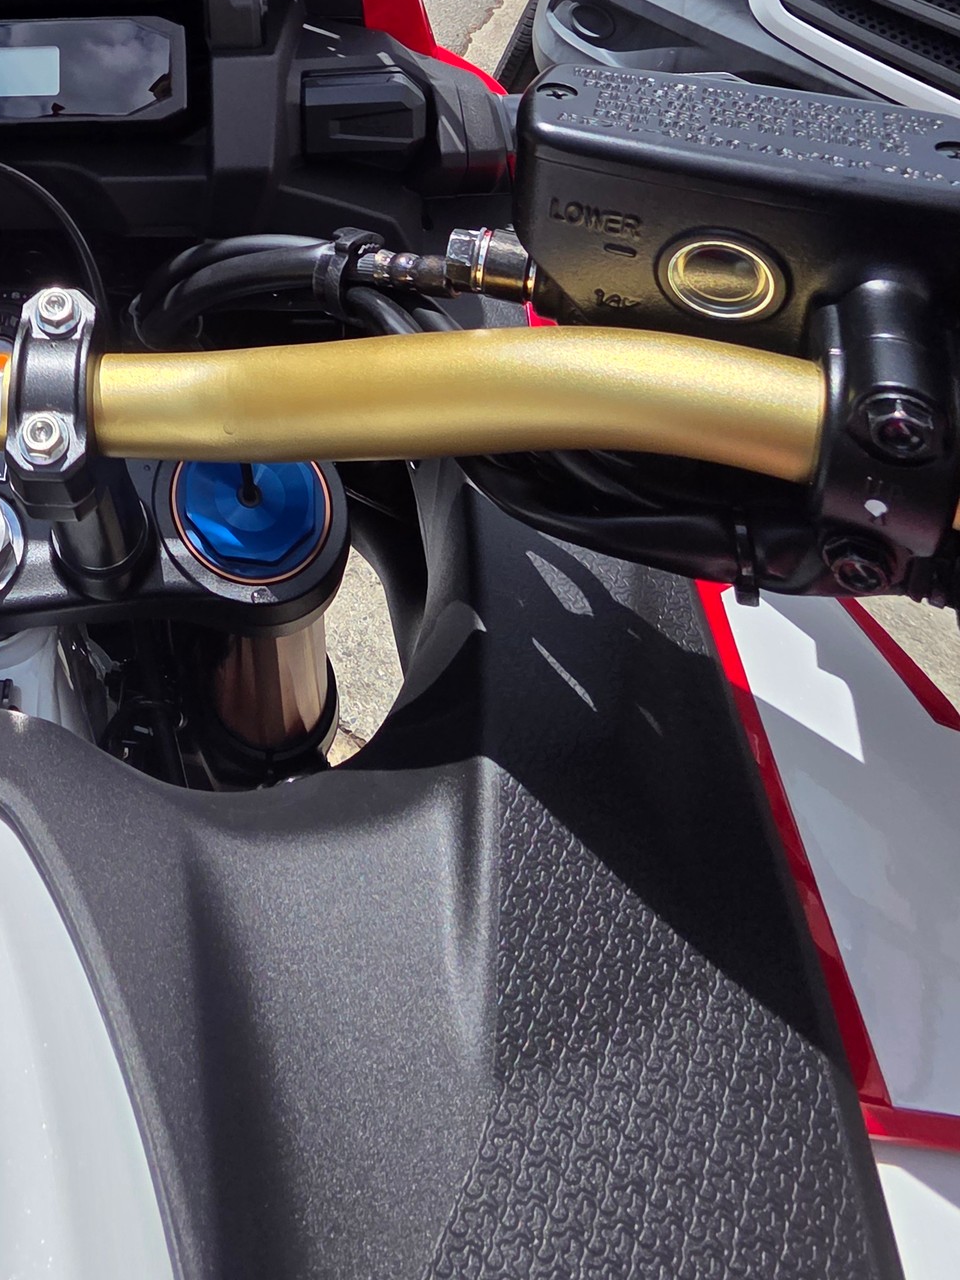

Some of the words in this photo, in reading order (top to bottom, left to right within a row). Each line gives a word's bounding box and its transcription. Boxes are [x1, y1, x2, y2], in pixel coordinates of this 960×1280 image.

[573, 66, 656, 88] WARNING
[661, 81, 697, 96] USE
[807, 101, 876, 120] BRAKE
[882, 111, 944, 131] FLUID
[583, 78, 630, 93] FROM
[593, 108, 649, 124] FREIN
[598, 90, 662, 107] FILLER
[667, 100, 704, 113] CAP
[709, 106, 786, 127] BEFORE
[710, 116, 750, 131] QUE
[757, 124, 786, 137] DU
[879, 141, 911, 157] DE
[549, 197, 642, 240] LOWER
